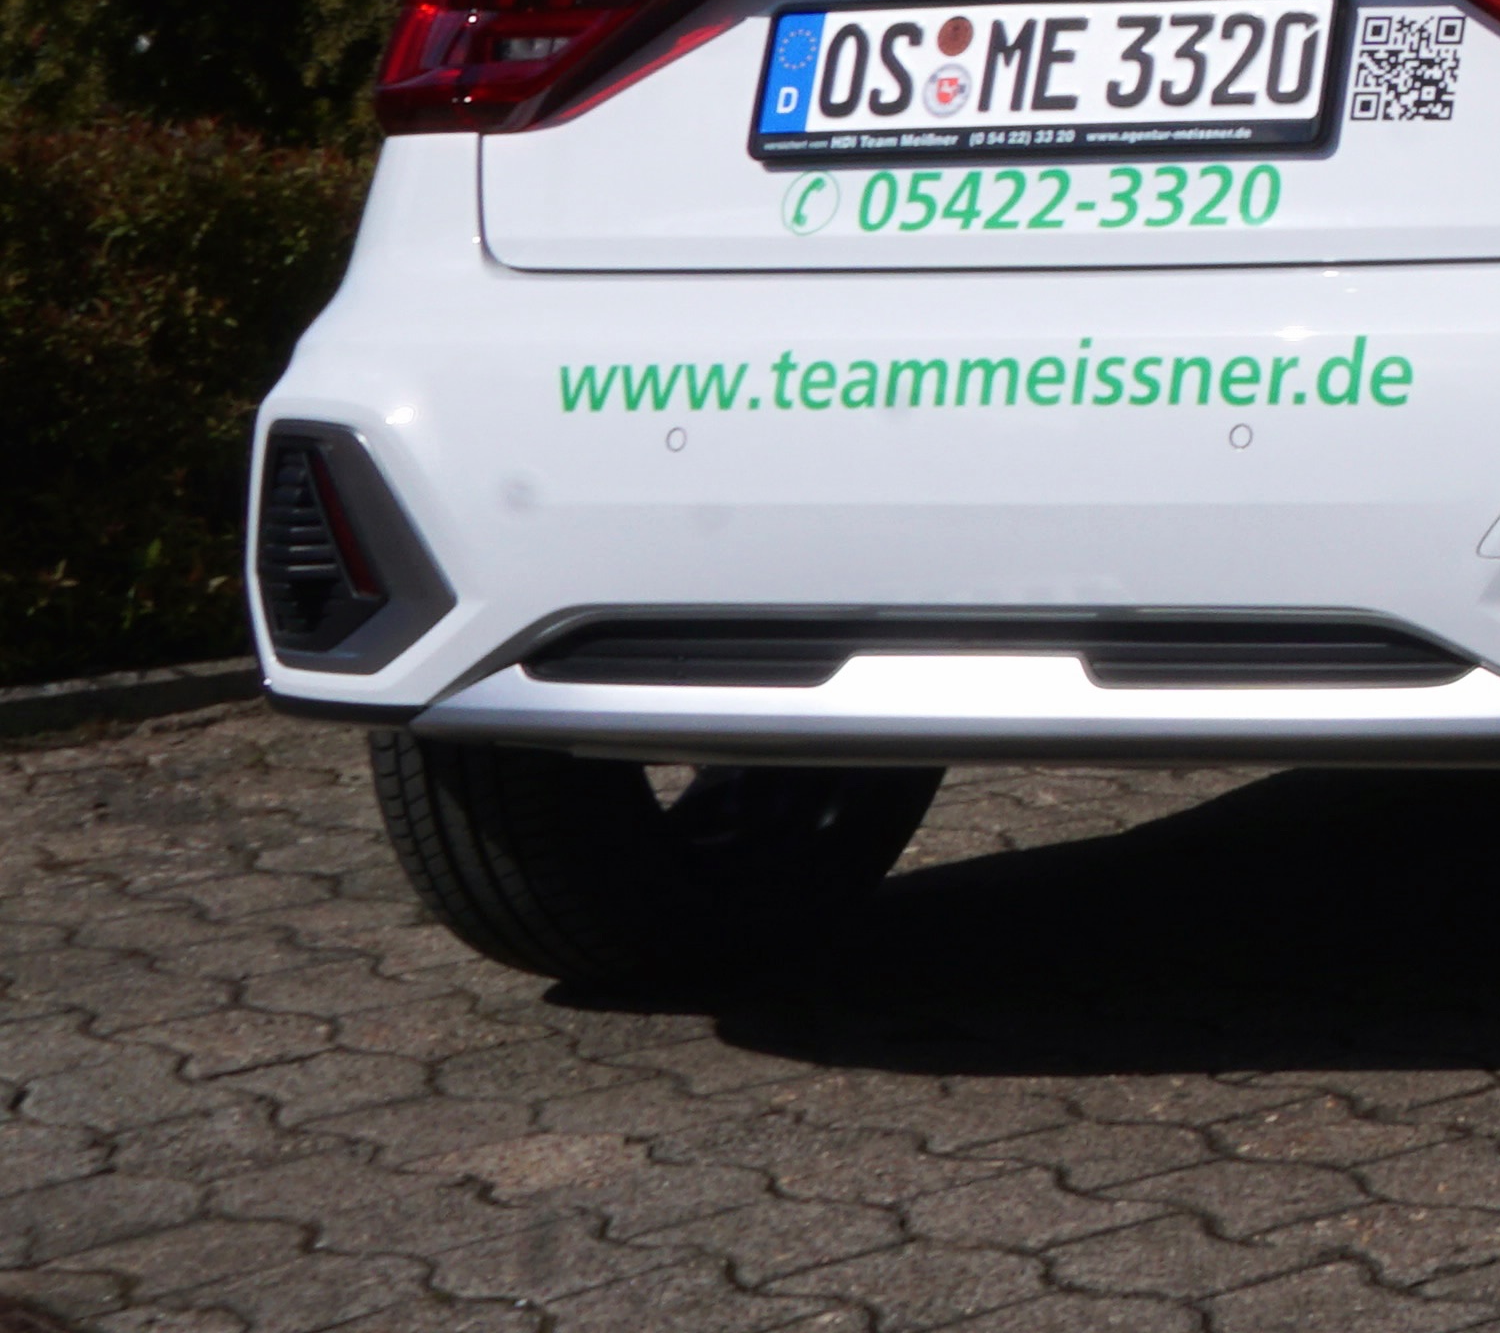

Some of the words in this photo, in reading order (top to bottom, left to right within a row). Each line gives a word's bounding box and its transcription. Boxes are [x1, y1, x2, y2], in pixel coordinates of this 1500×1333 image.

[1105, 11, 1319, 109] 3320
[776, 86, 799, 114] D
[830, 135, 857, 149] HDI
[860, 134, 897, 148] Team
[900, 133, 959, 147] Meißner
[857, 163, 1282, 232] 05422-3320
[559, 335, 1415, 413] www.teammeissner.de
